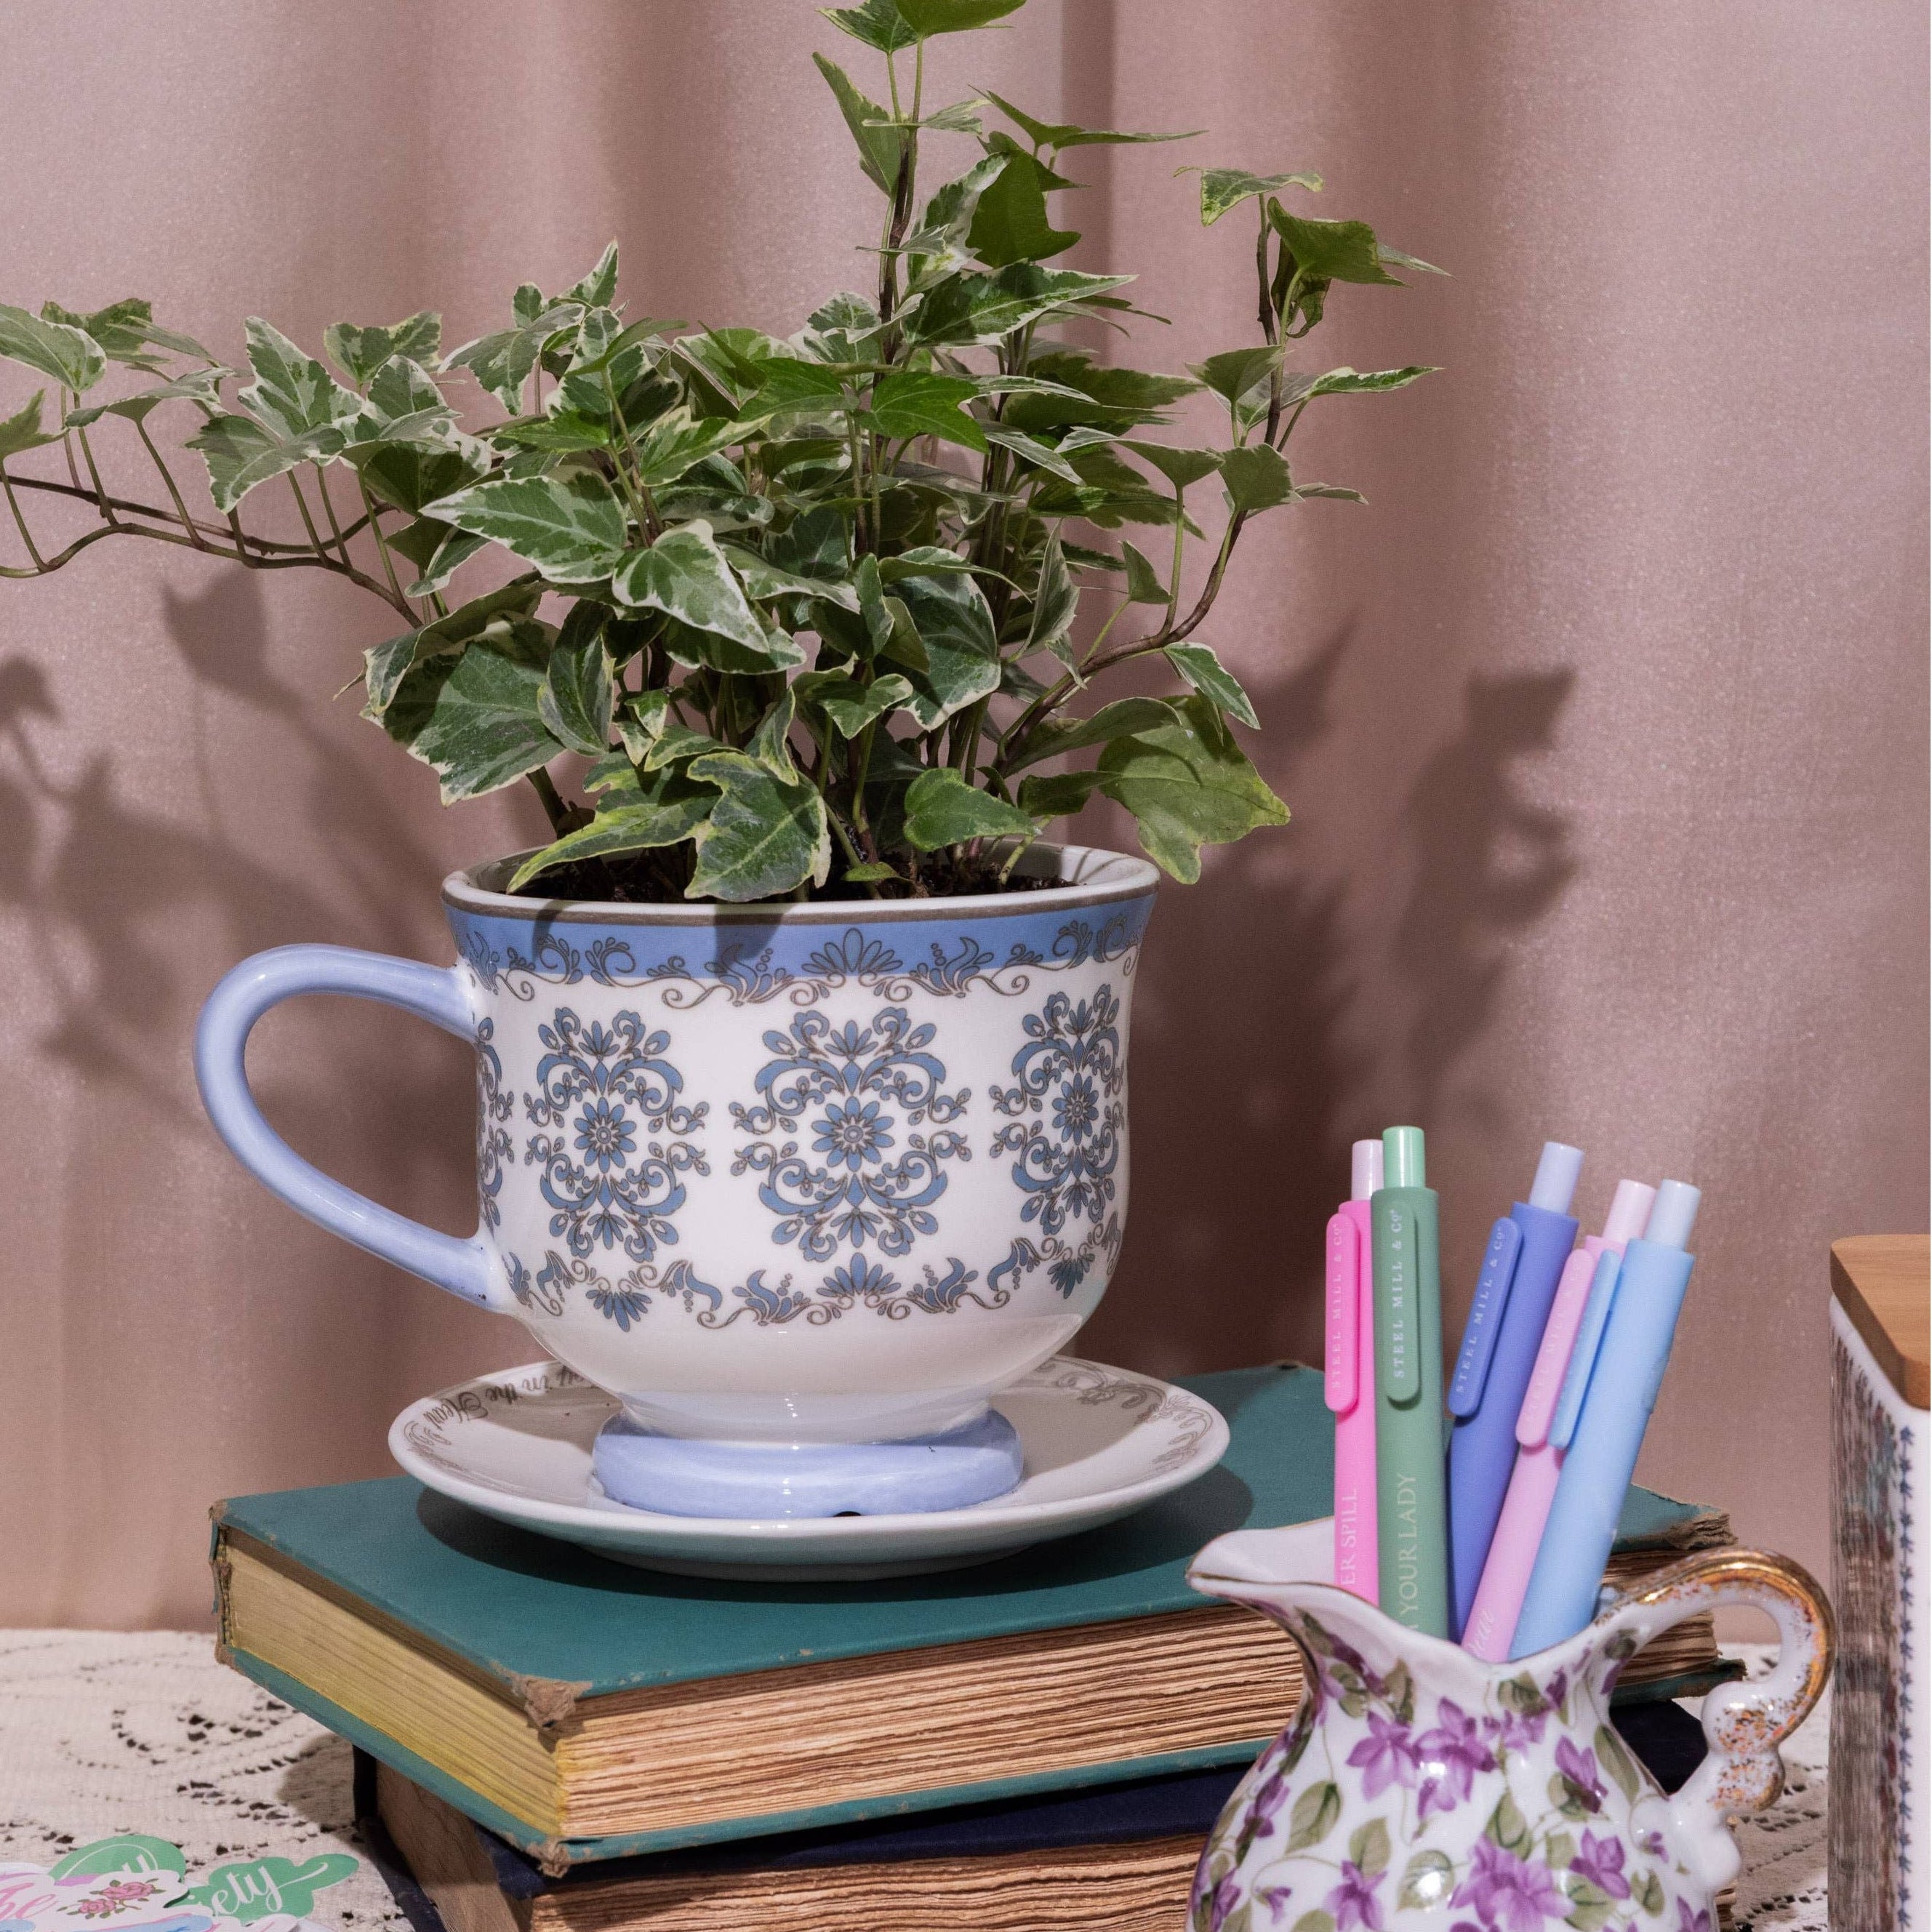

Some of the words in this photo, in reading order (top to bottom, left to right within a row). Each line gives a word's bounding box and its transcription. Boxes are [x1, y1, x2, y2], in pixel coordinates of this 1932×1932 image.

[1392, 1239, 1402, 1250] &
[1333, 1274, 1342, 1320] MILL
[1392, 1262, 1403, 1308] MILL
[1331, 1331, 1342, 1390] STEEL
[1392, 1320, 1405, 1379] STEEL
[1456, 1336, 1477, 1393] STEEL
[1474, 1280, 1493, 1325] MILL
[485, 1383, 521, 1405] the
[521, 1375, 553, 1393] in
[423, 1392, 489, 1431] Heart
[1340, 1488, 1358, 1549] SPILL
[1396, 1472, 1418, 1539] LADY
[1397, 1539, 1419, 1616] YOUR
